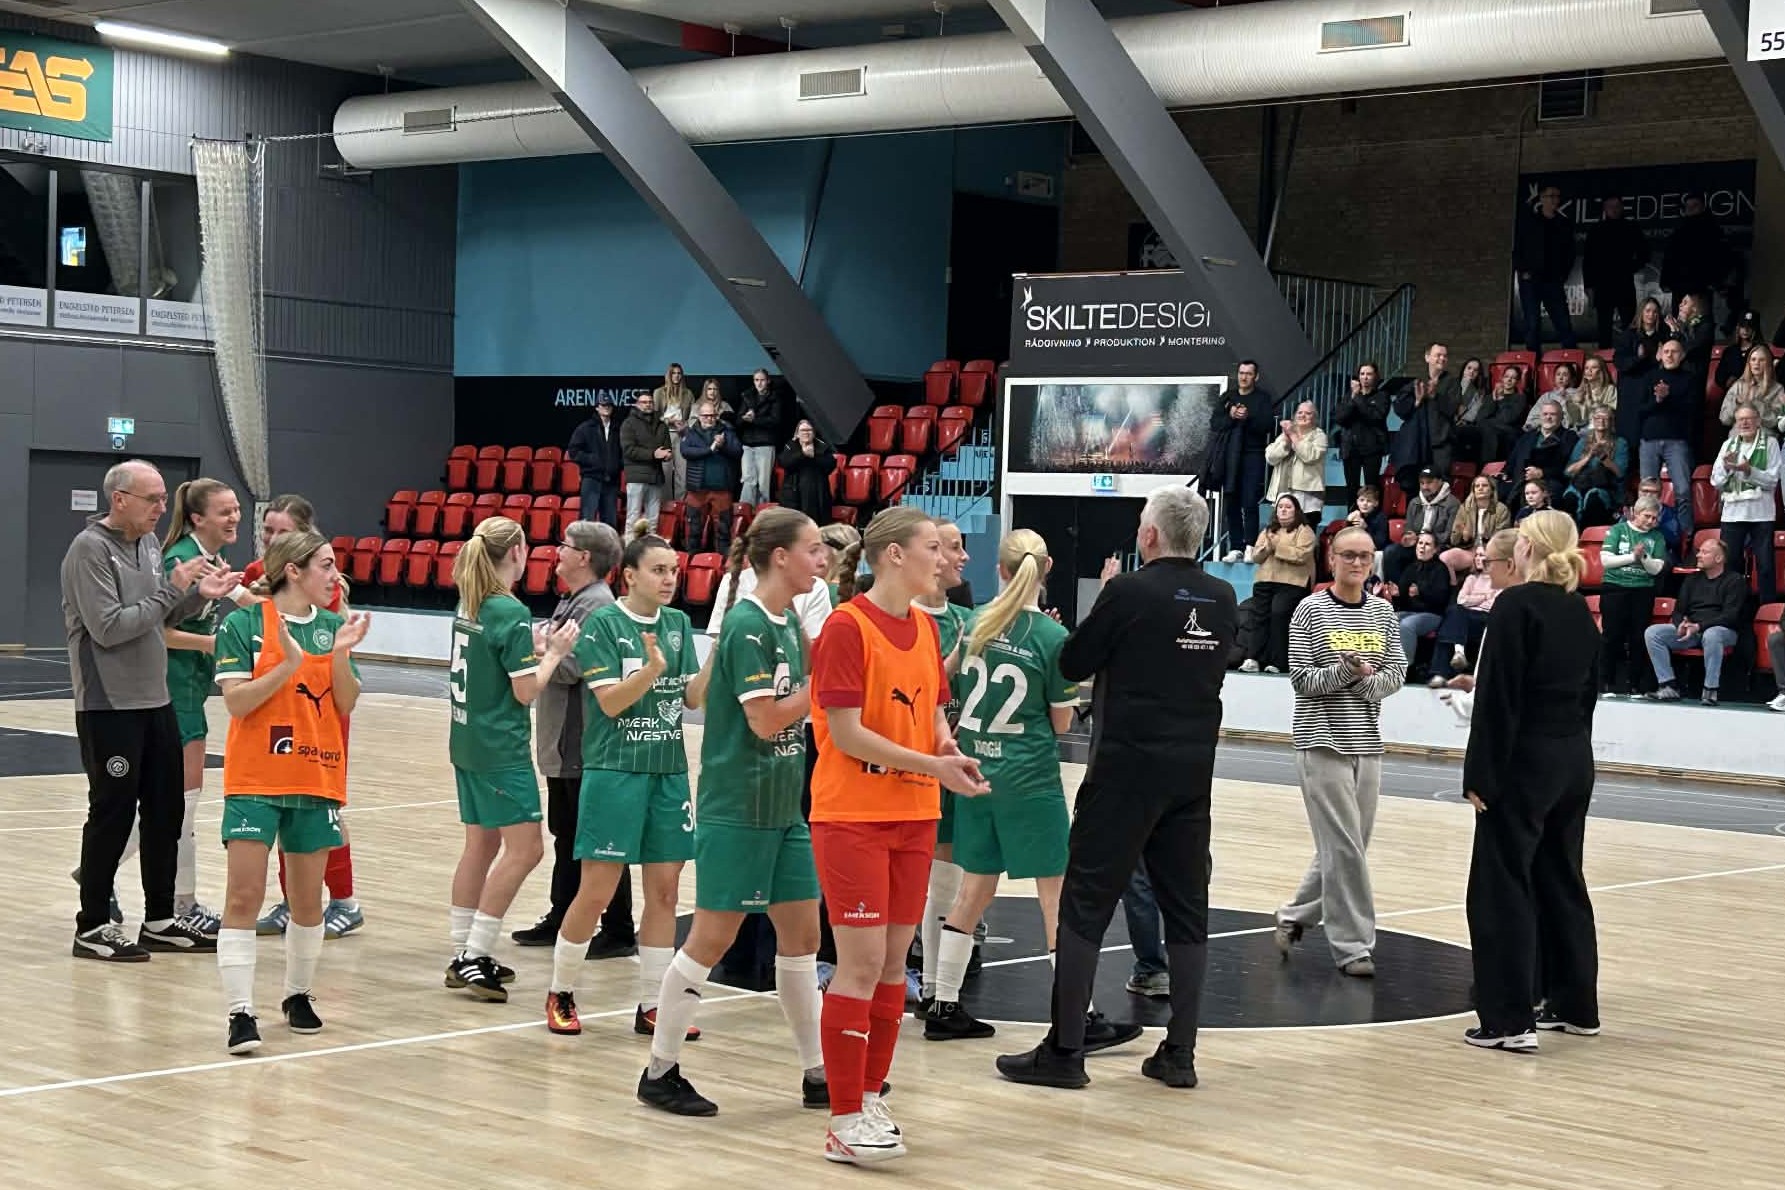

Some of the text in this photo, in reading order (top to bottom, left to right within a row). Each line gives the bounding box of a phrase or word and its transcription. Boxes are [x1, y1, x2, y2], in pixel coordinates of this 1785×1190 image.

[1761, 32, 1785, 51] 55
[1026, 301, 1211, 331] SKILTEDESIG
[1093, 337, 1156, 348] PRODUKTION
[1168, 337, 1226, 346] MONTERING
[450, 631, 470, 703] 5
[959, 655, 1028, 734] 22
